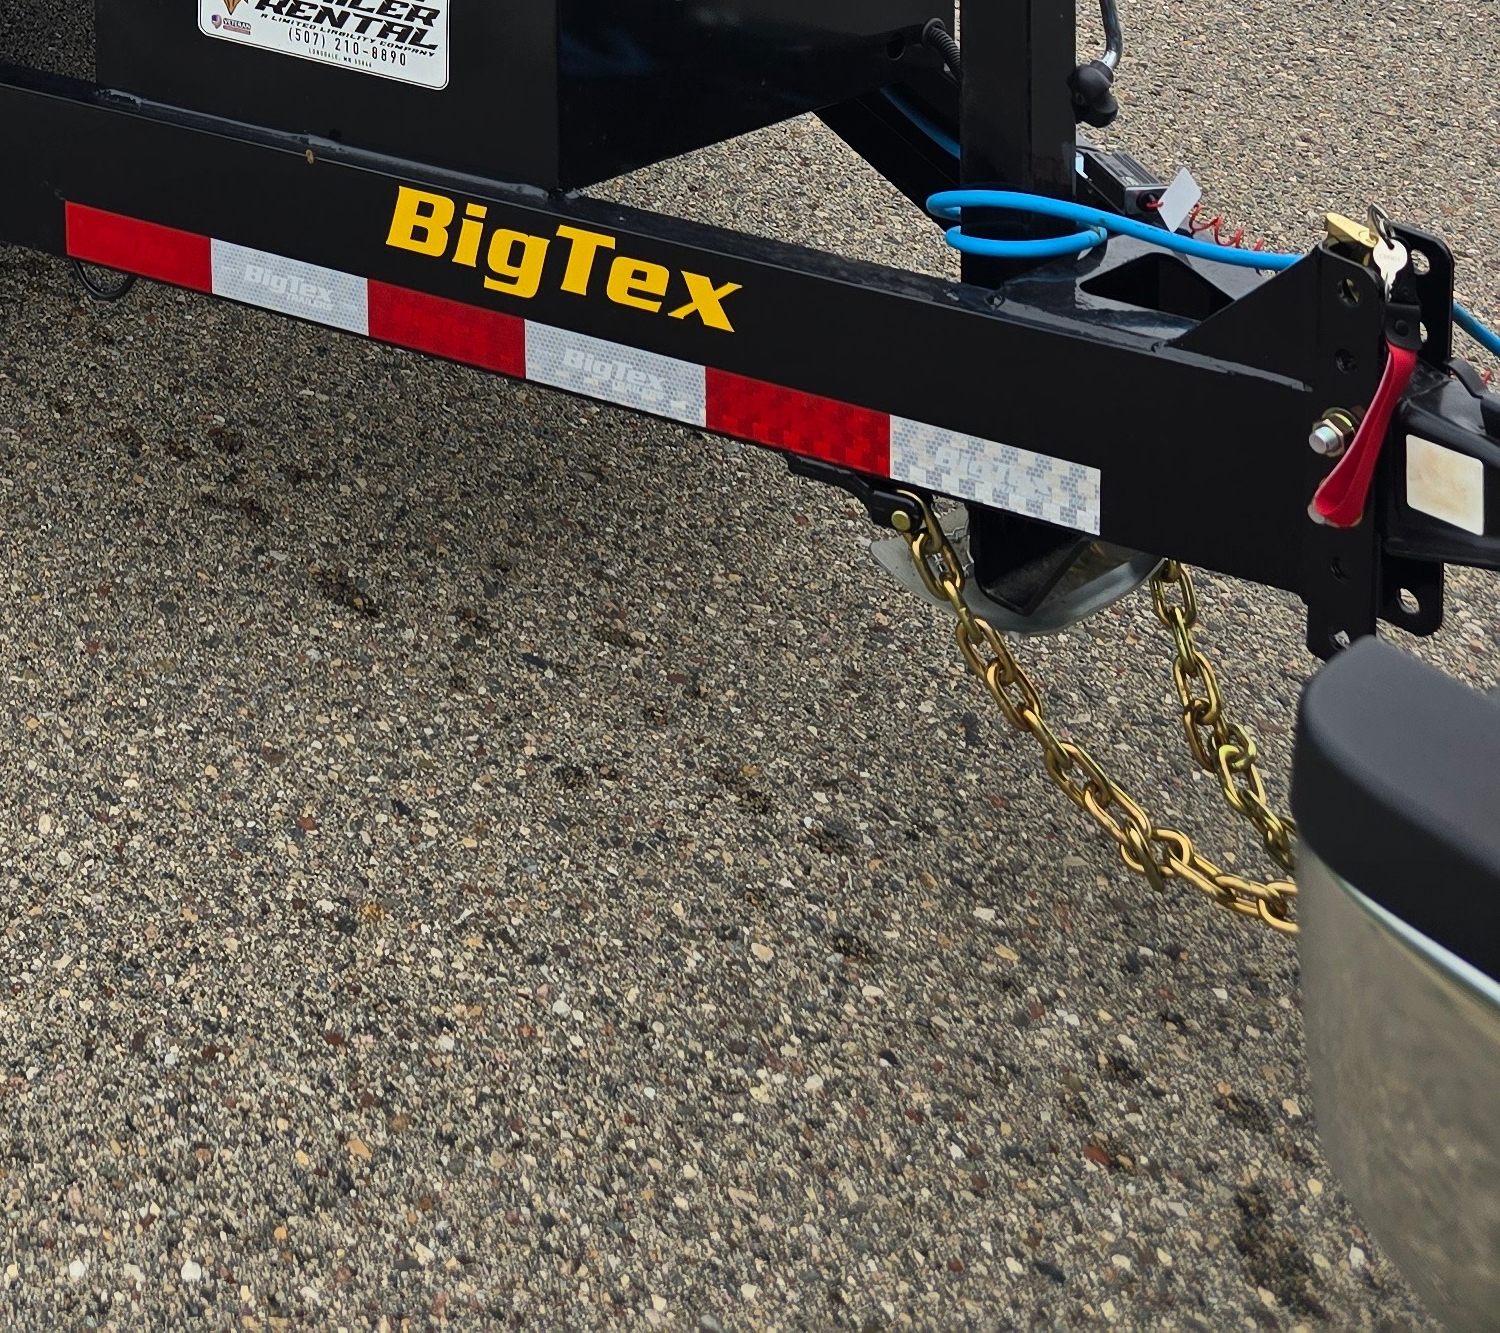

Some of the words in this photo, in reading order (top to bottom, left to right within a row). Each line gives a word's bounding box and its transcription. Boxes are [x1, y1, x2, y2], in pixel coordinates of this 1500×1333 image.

[271, 15, 317, 30] LIMITED
[320, 26, 376, 44] LIABILITY
[379, 40, 436, 57] COMPANY
[288, 27, 325, 49] (507)
[334, 37, 406, 66] 210-8890
[385, 185, 743, 333] BigTex
[243, 263, 334, 304] BigTex
[563, 347, 666, 391] BigTex
